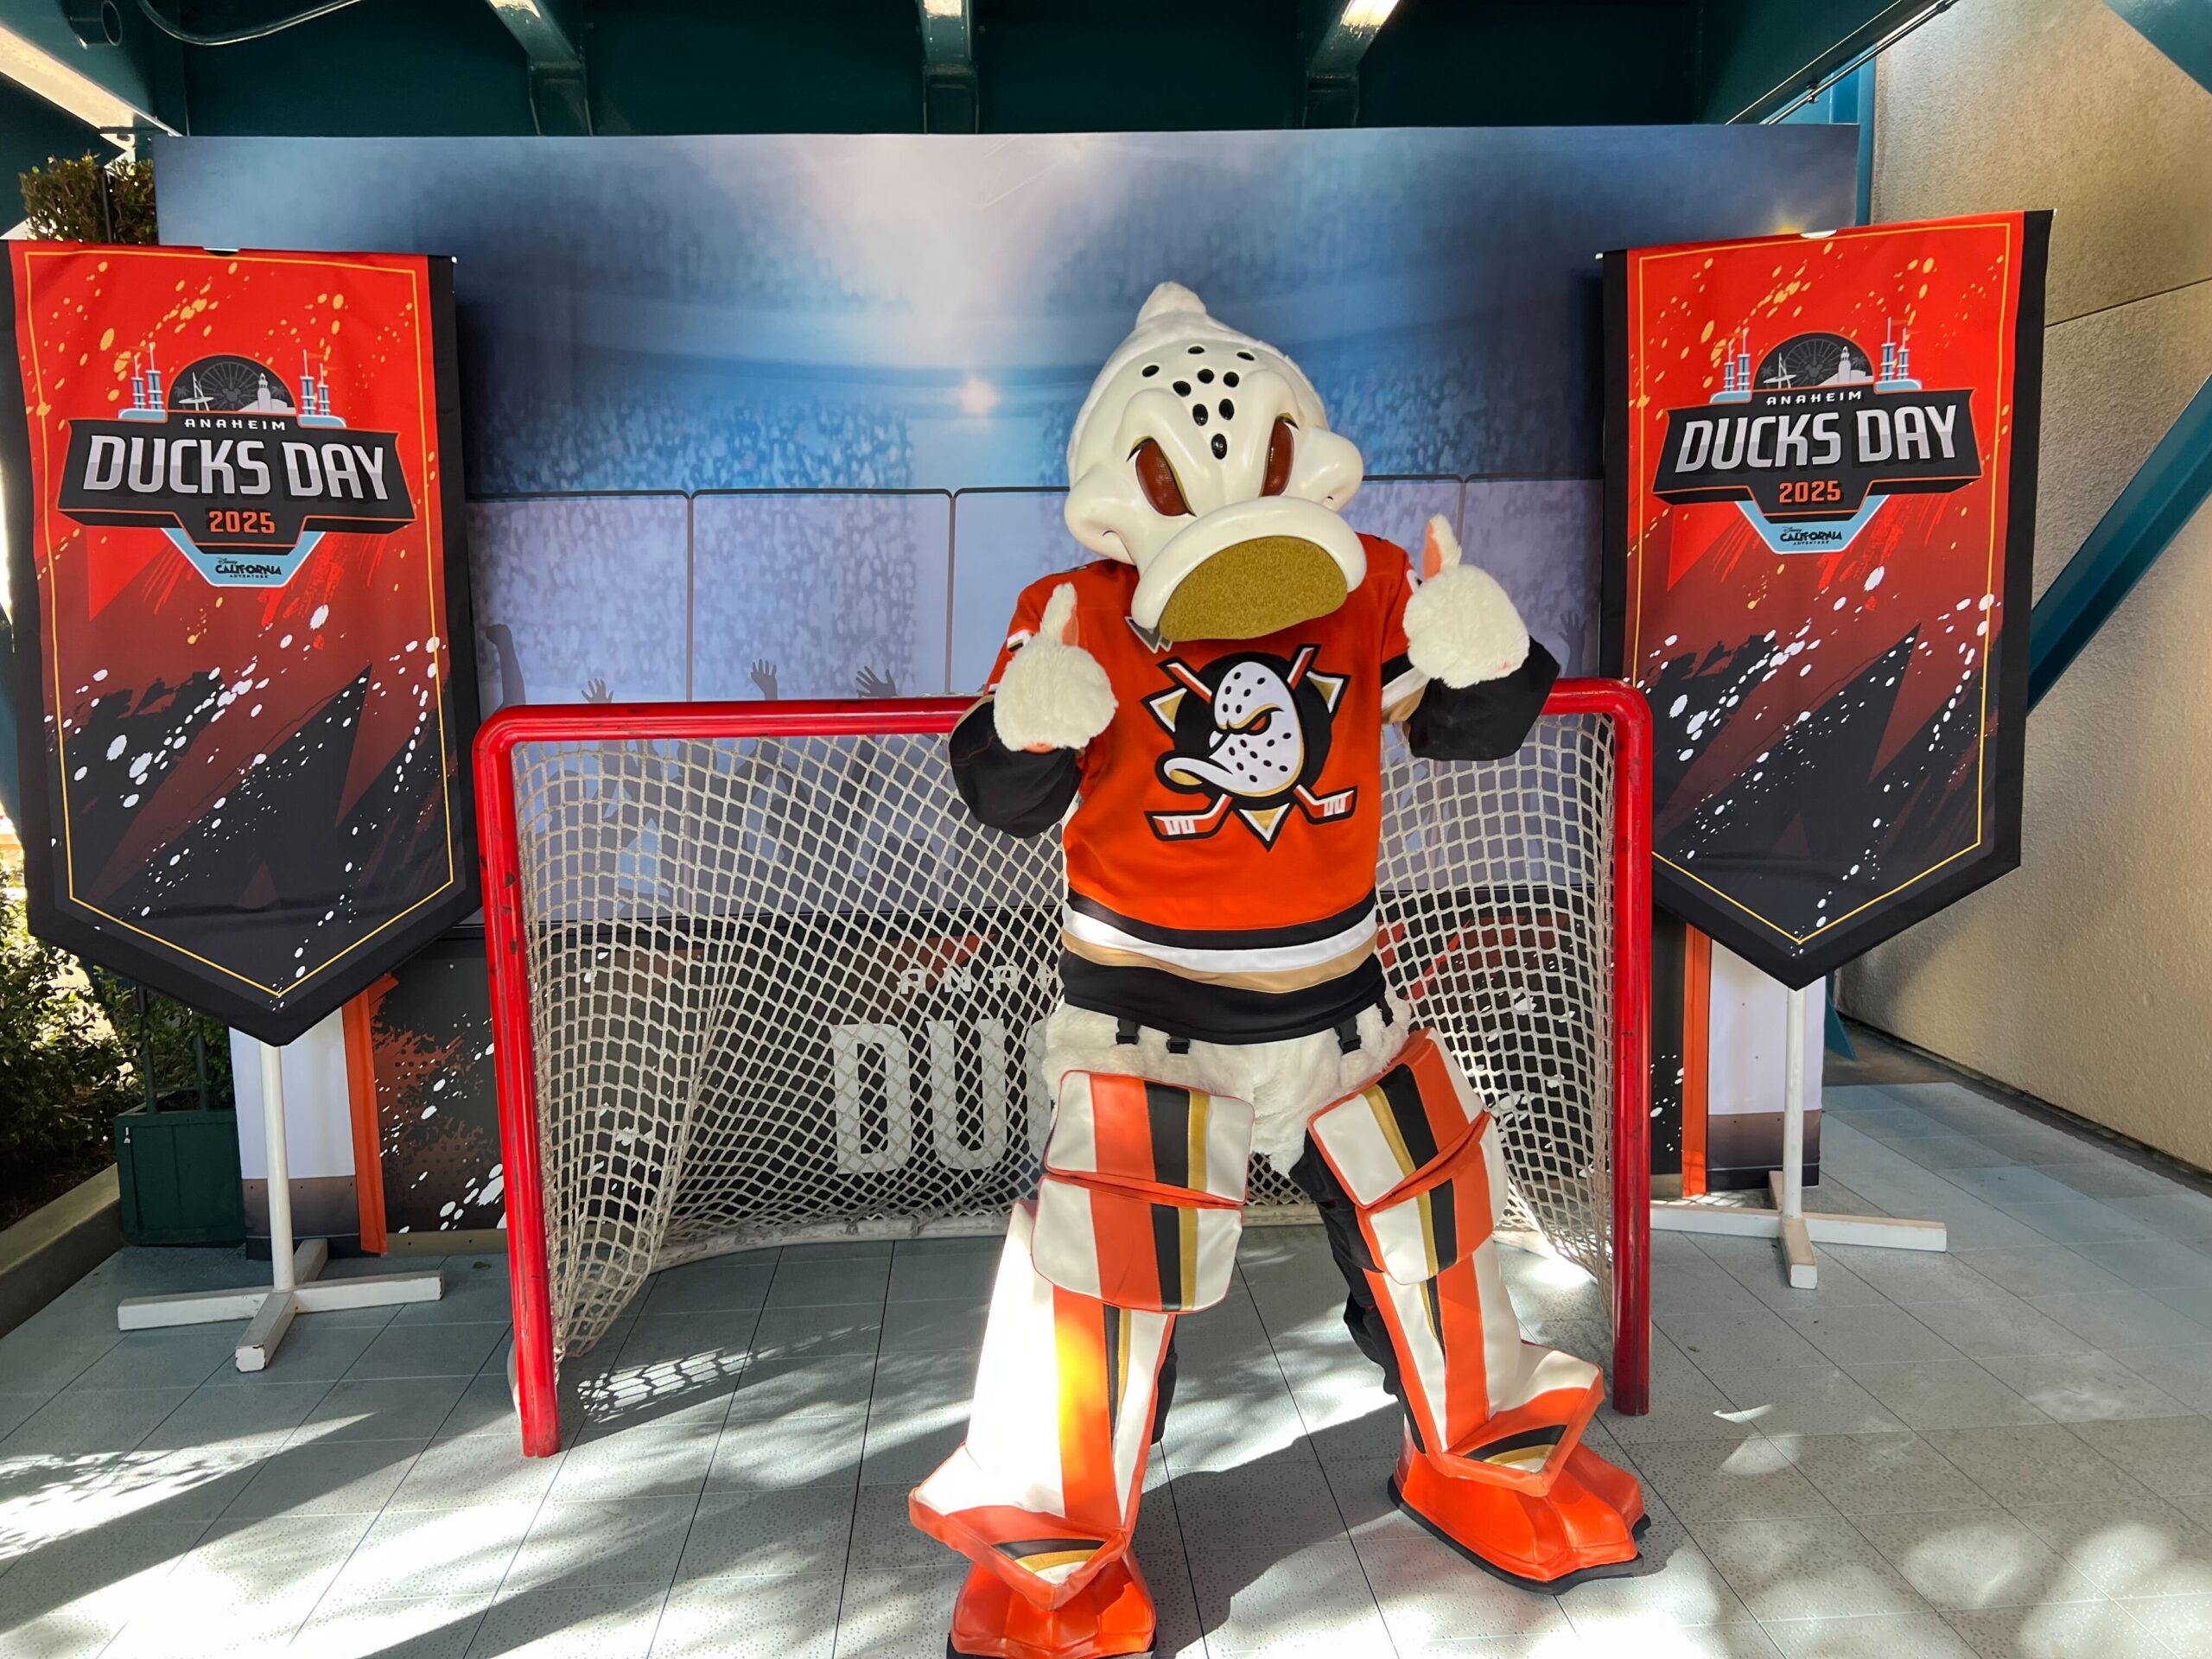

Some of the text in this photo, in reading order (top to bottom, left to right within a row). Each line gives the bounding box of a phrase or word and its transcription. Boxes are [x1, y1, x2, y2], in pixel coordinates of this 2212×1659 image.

[1766, 391, 1862, 406] ANAHEIM
[184, 418, 287, 430] ANAHEIM
[1675, 404, 1956, 473] DUCKS DAY
[83, 435, 389, 499] DUCKS DAY
[1779, 480, 1841, 503] 2025
[208, 511, 276, 533] 2025
[1780, 531, 1842, 542] CALIFORNIA
[215, 564, 282, 575] CALIFORNIA
